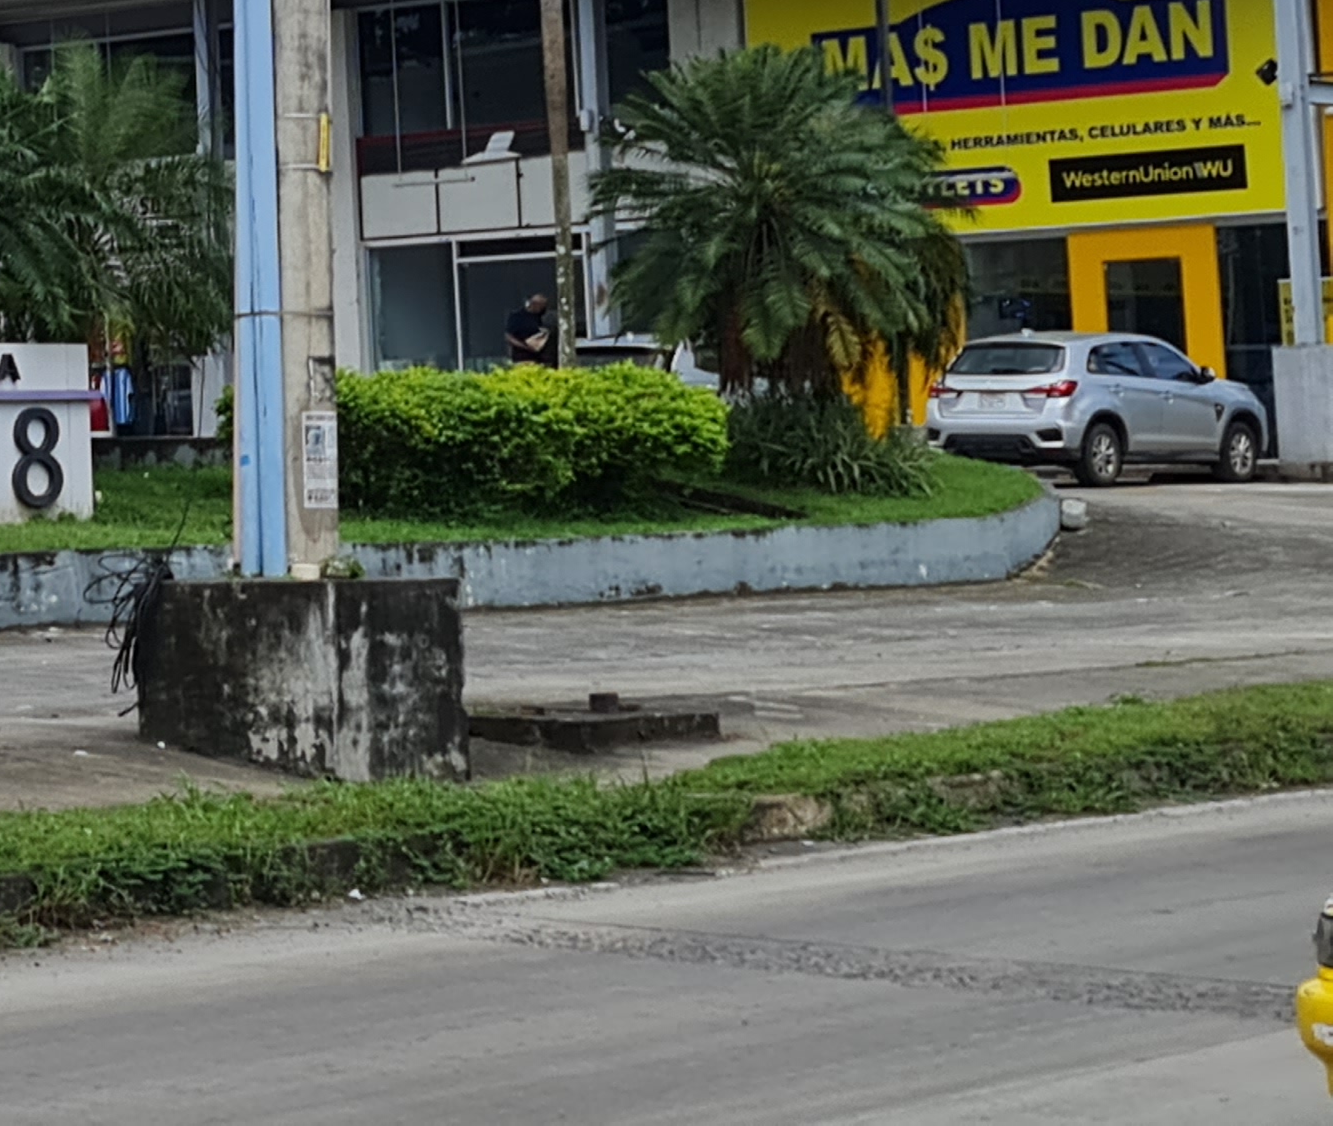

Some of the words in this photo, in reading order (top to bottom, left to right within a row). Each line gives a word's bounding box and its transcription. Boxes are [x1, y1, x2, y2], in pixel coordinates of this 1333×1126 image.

[821, 23, 949, 92] MA$
[968, 14, 1060, 80] ME
[950, 127, 1084, 152] HERRAMIENTAS,
[1087, 118, 1187, 140] CELULARES
[1191, 117, 1203, 132] Y
[1062, 163, 1193, 189] WesternUnion
[11, 407, 65, 509] 8
